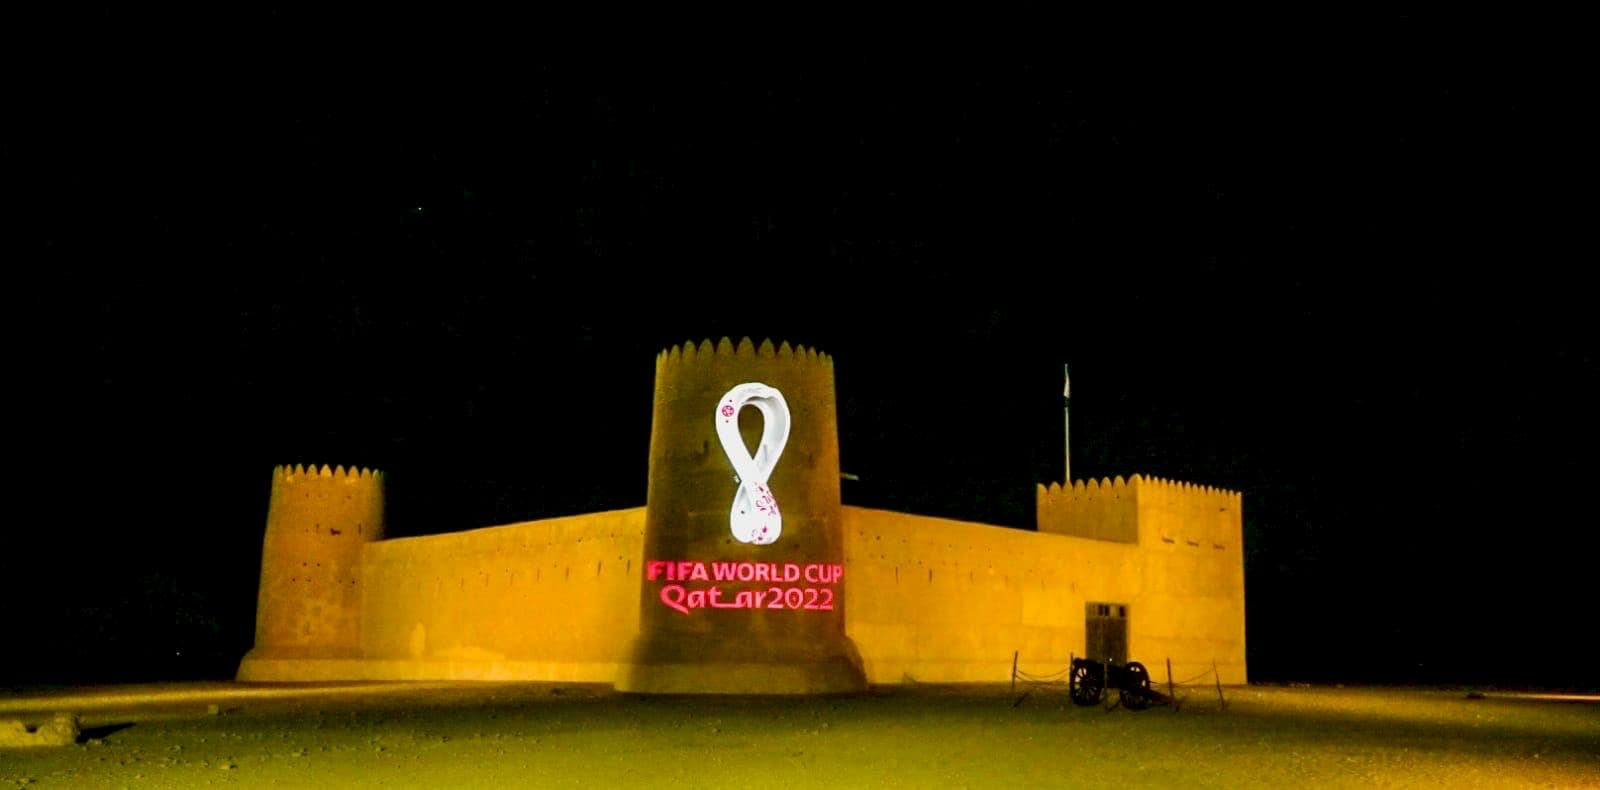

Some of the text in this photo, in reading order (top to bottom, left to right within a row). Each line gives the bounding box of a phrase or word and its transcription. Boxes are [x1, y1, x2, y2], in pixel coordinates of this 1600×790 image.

[647, 560, 843, 583] FIFA WORLD CUP
